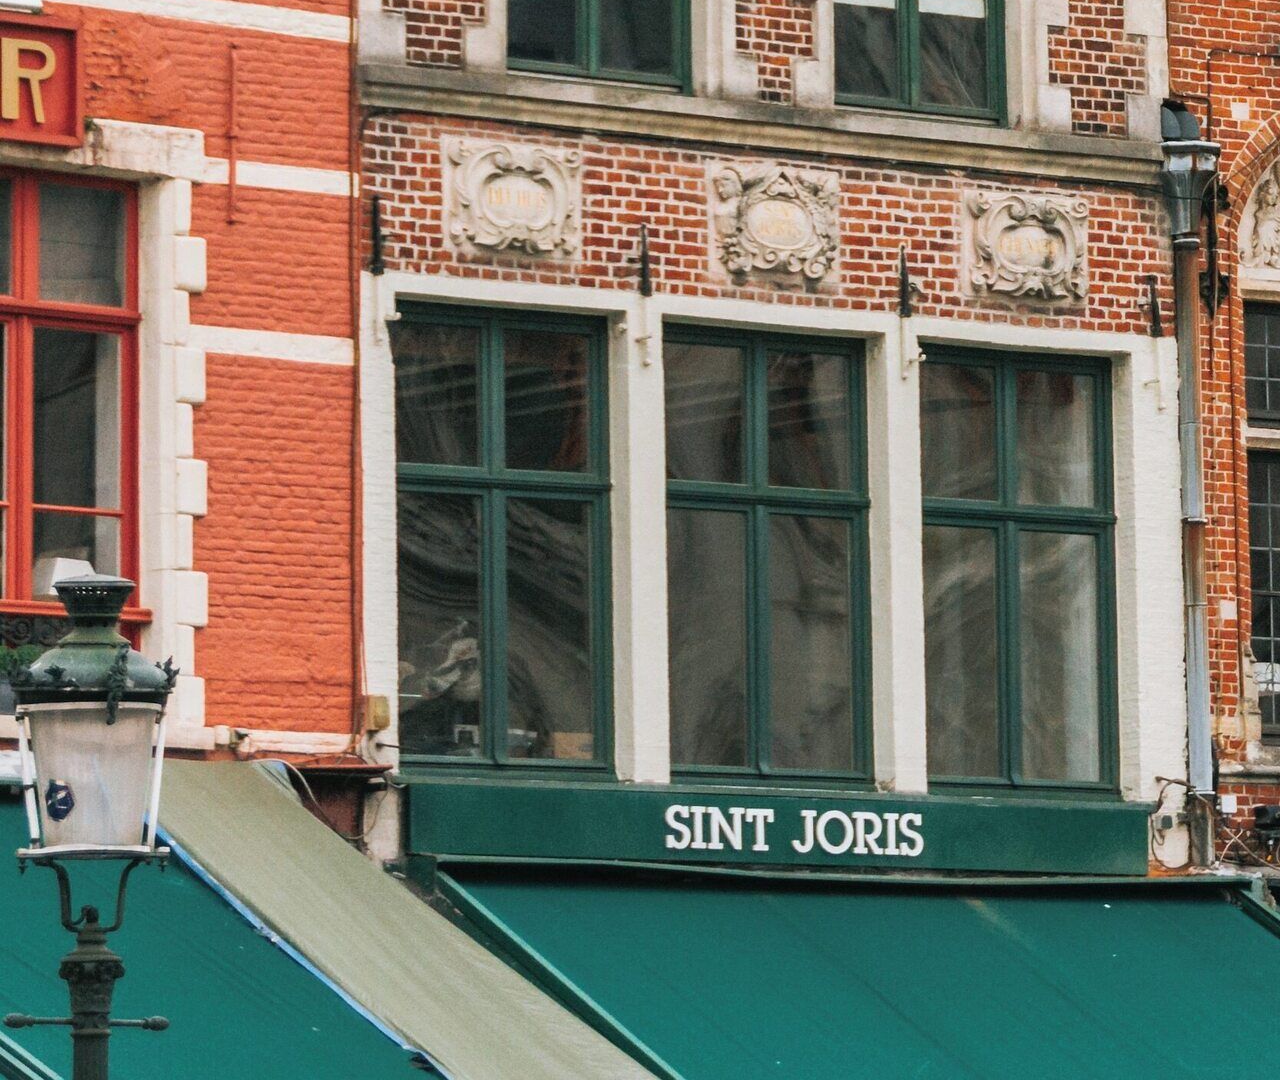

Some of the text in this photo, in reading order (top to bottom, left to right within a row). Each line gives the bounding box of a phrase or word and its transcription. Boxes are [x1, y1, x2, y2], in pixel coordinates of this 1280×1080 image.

[1, 37, 56, 124] R
[665, 804, 925, 857] SINT JORIS
